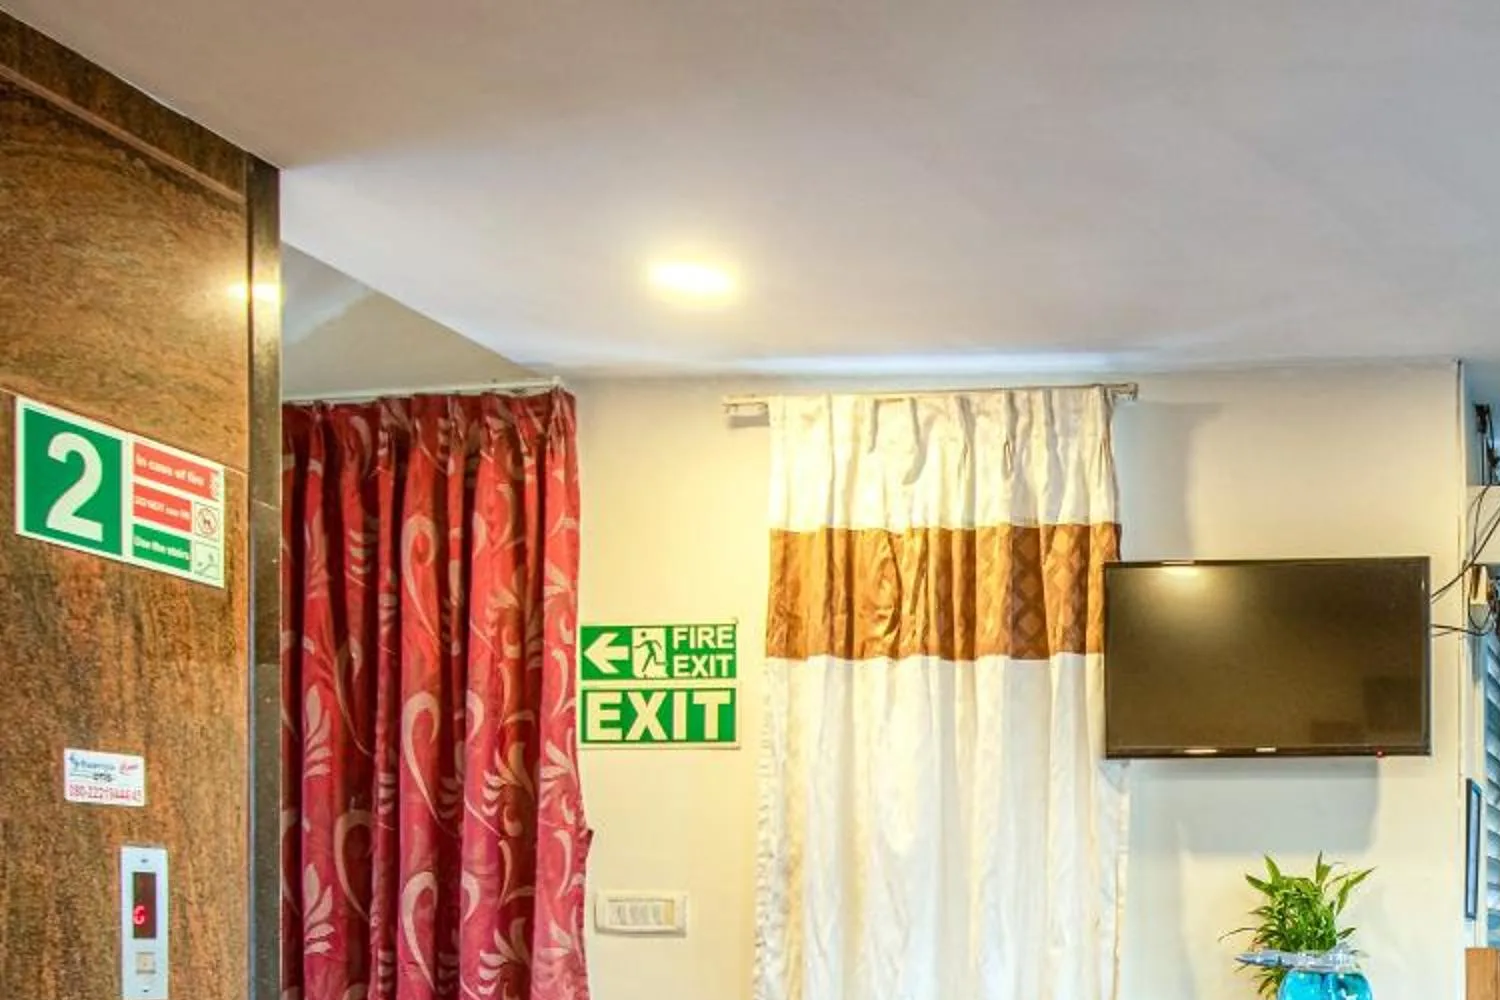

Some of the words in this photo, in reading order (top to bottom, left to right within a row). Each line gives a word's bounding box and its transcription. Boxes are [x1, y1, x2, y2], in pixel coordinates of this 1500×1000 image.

[46, 431, 103, 542] 2
[673, 627, 734, 649] FIRE
[673, 655, 733, 677] EXIT
[587, 691, 730, 741] EXIT
